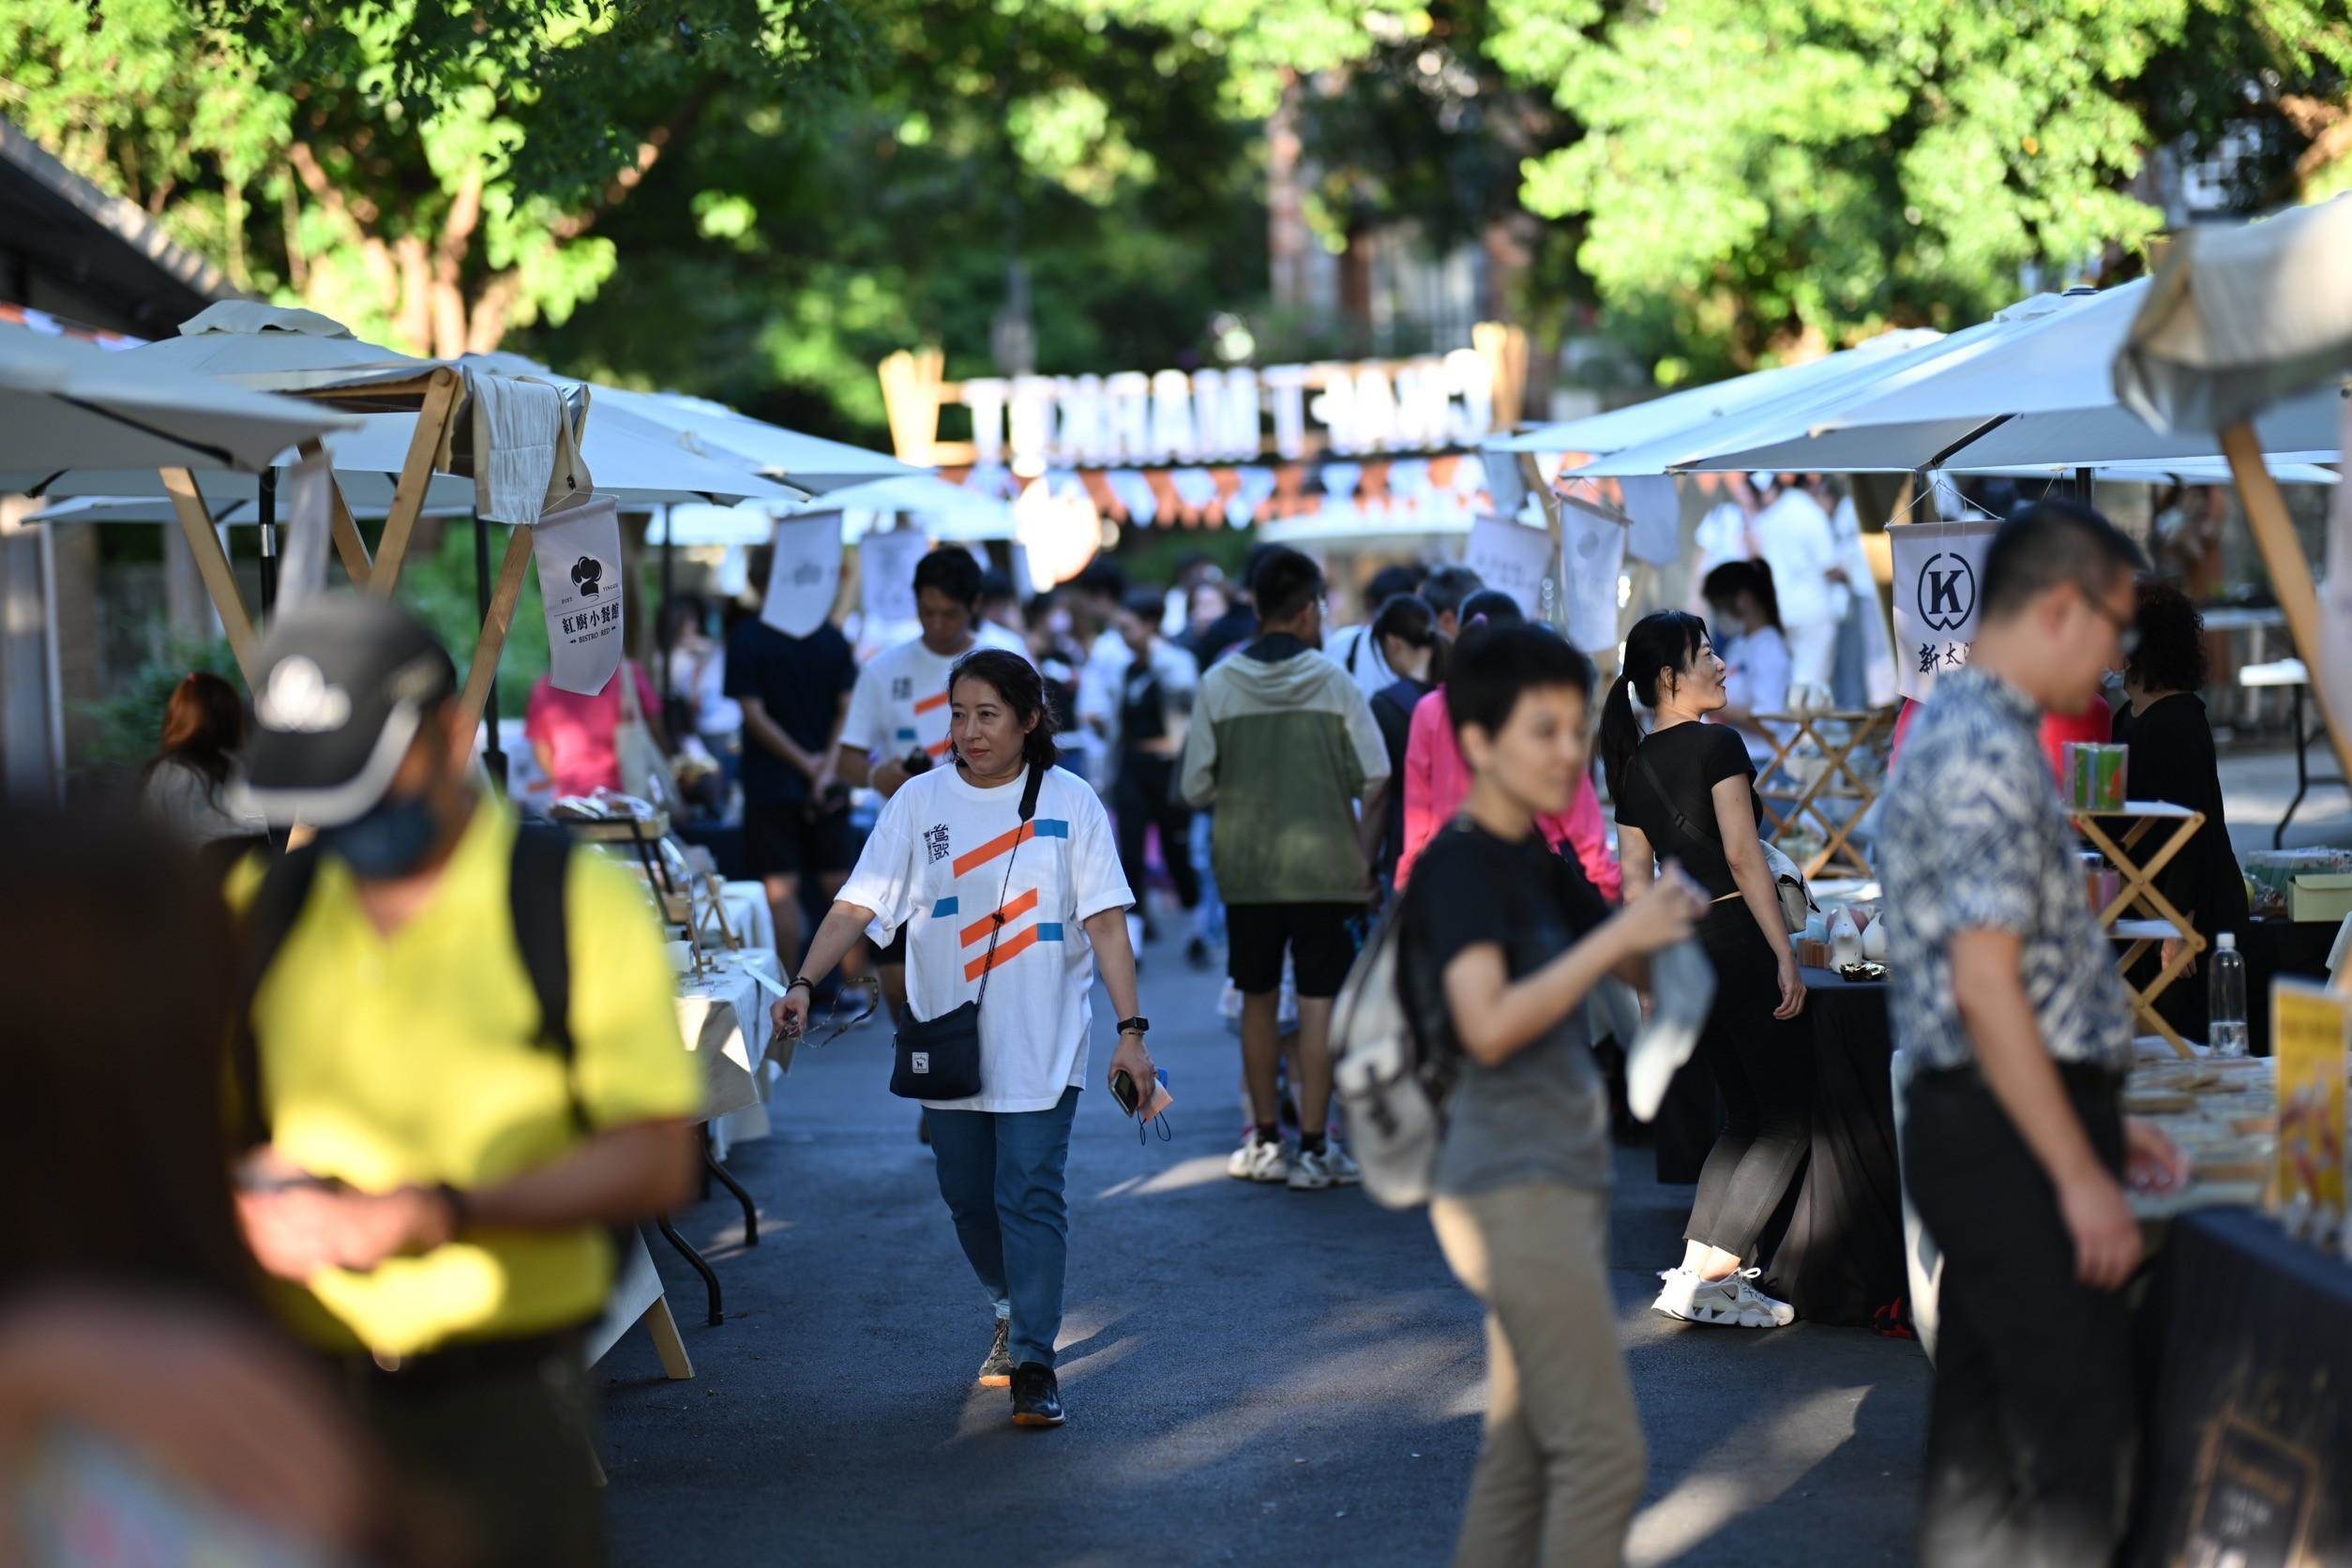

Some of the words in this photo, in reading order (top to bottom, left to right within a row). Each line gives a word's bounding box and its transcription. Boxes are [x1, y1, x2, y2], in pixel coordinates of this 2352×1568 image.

[1928, 569, 1964, 614] K
[579, 632, 599, 643] BISTRO
[600, 627, 611, 637] RED
